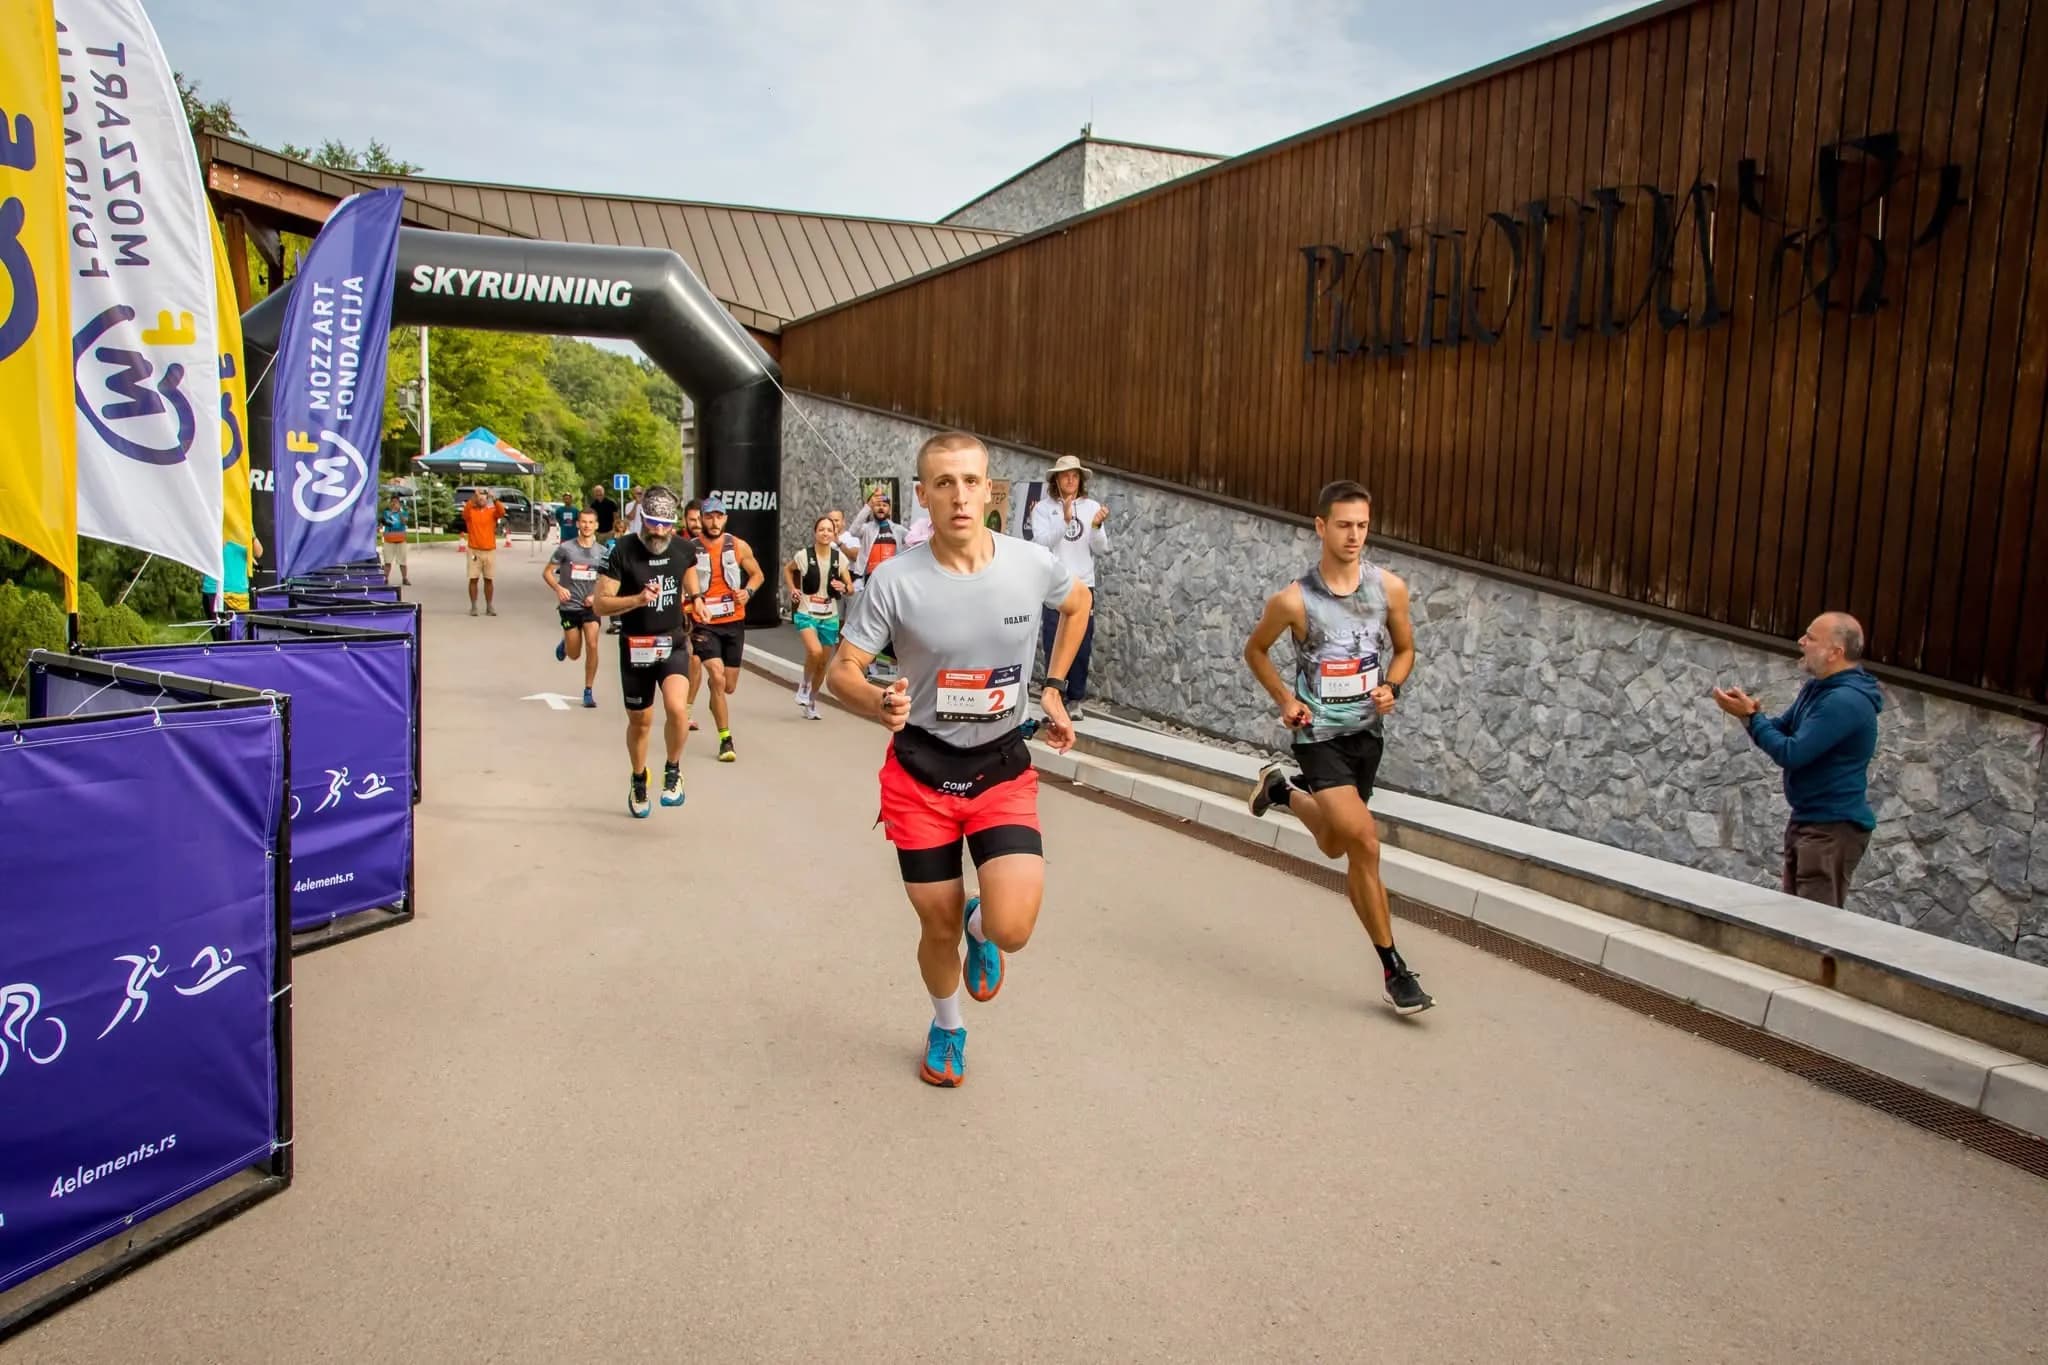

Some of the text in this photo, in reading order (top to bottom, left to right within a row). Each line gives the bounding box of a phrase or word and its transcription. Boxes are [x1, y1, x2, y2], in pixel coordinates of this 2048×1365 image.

[410, 264, 633, 309] SKYRUNNING
[310, 281, 336, 412] MOZZART
[337, 275, 365, 422] FONDACIJA
[1361, 674, 1368, 691] 1
[946, 695, 976, 703] TEAM
[988, 689, 1006, 712] 2
[942, 781, 973, 792] COMP
[292, 872, 355, 893] 4elements.rs
[49, 1131, 178, 1199] 4elements.rs
